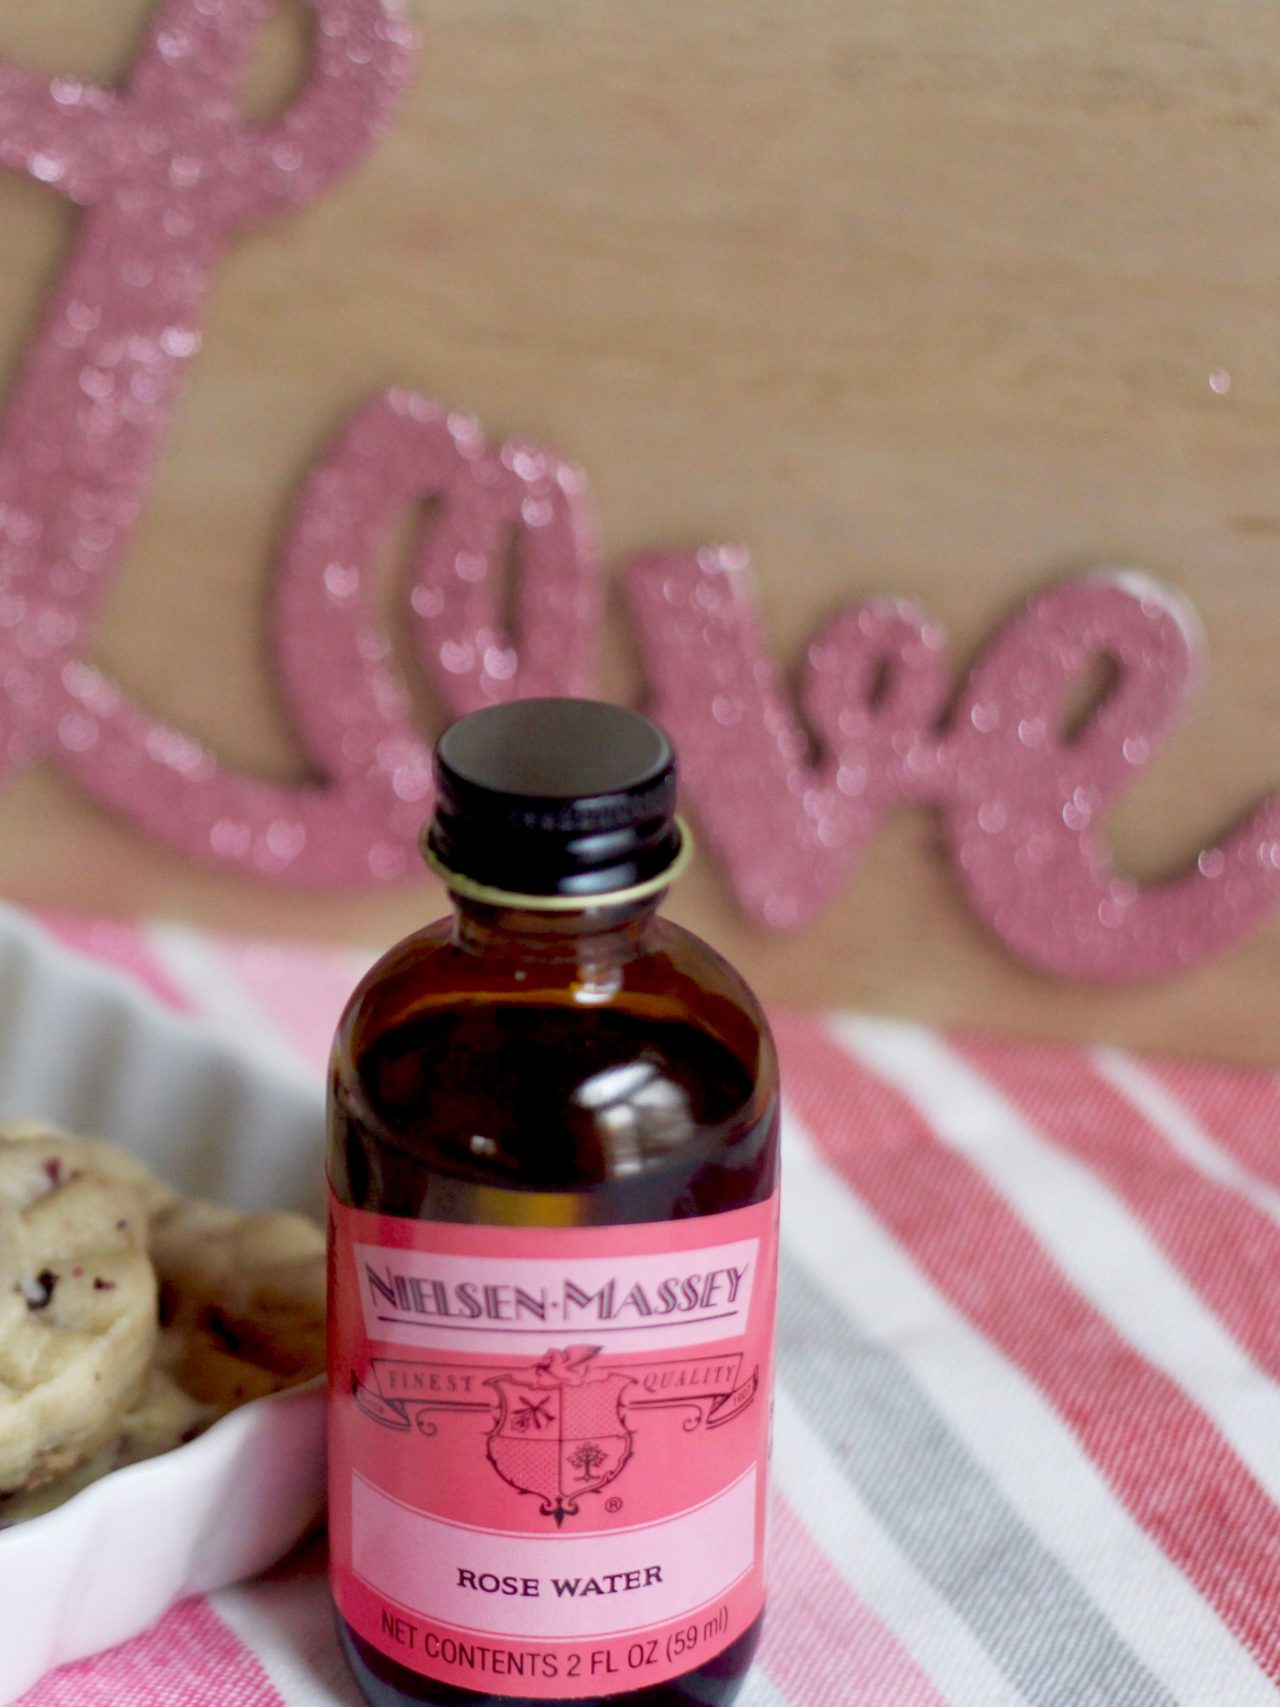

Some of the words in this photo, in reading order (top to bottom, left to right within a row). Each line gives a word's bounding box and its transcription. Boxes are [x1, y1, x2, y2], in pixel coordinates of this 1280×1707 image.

[387, 1369, 475, 1393] FINEST
[642, 1363, 737, 1394] QUALITY
[456, 1567, 540, 1597] ROSE
[550, 1565, 664, 1598] WATER
[381, 1608, 419, 1649] NET
[425, 1632, 559, 1678] CONTENTS
[567, 1654, 582, 1678] 2
[590, 1650, 619, 1676] FL
[628, 1641, 659, 1670] OZ
[666, 1625, 698, 1665] (59
[703, 1604, 730, 1644] ml)
